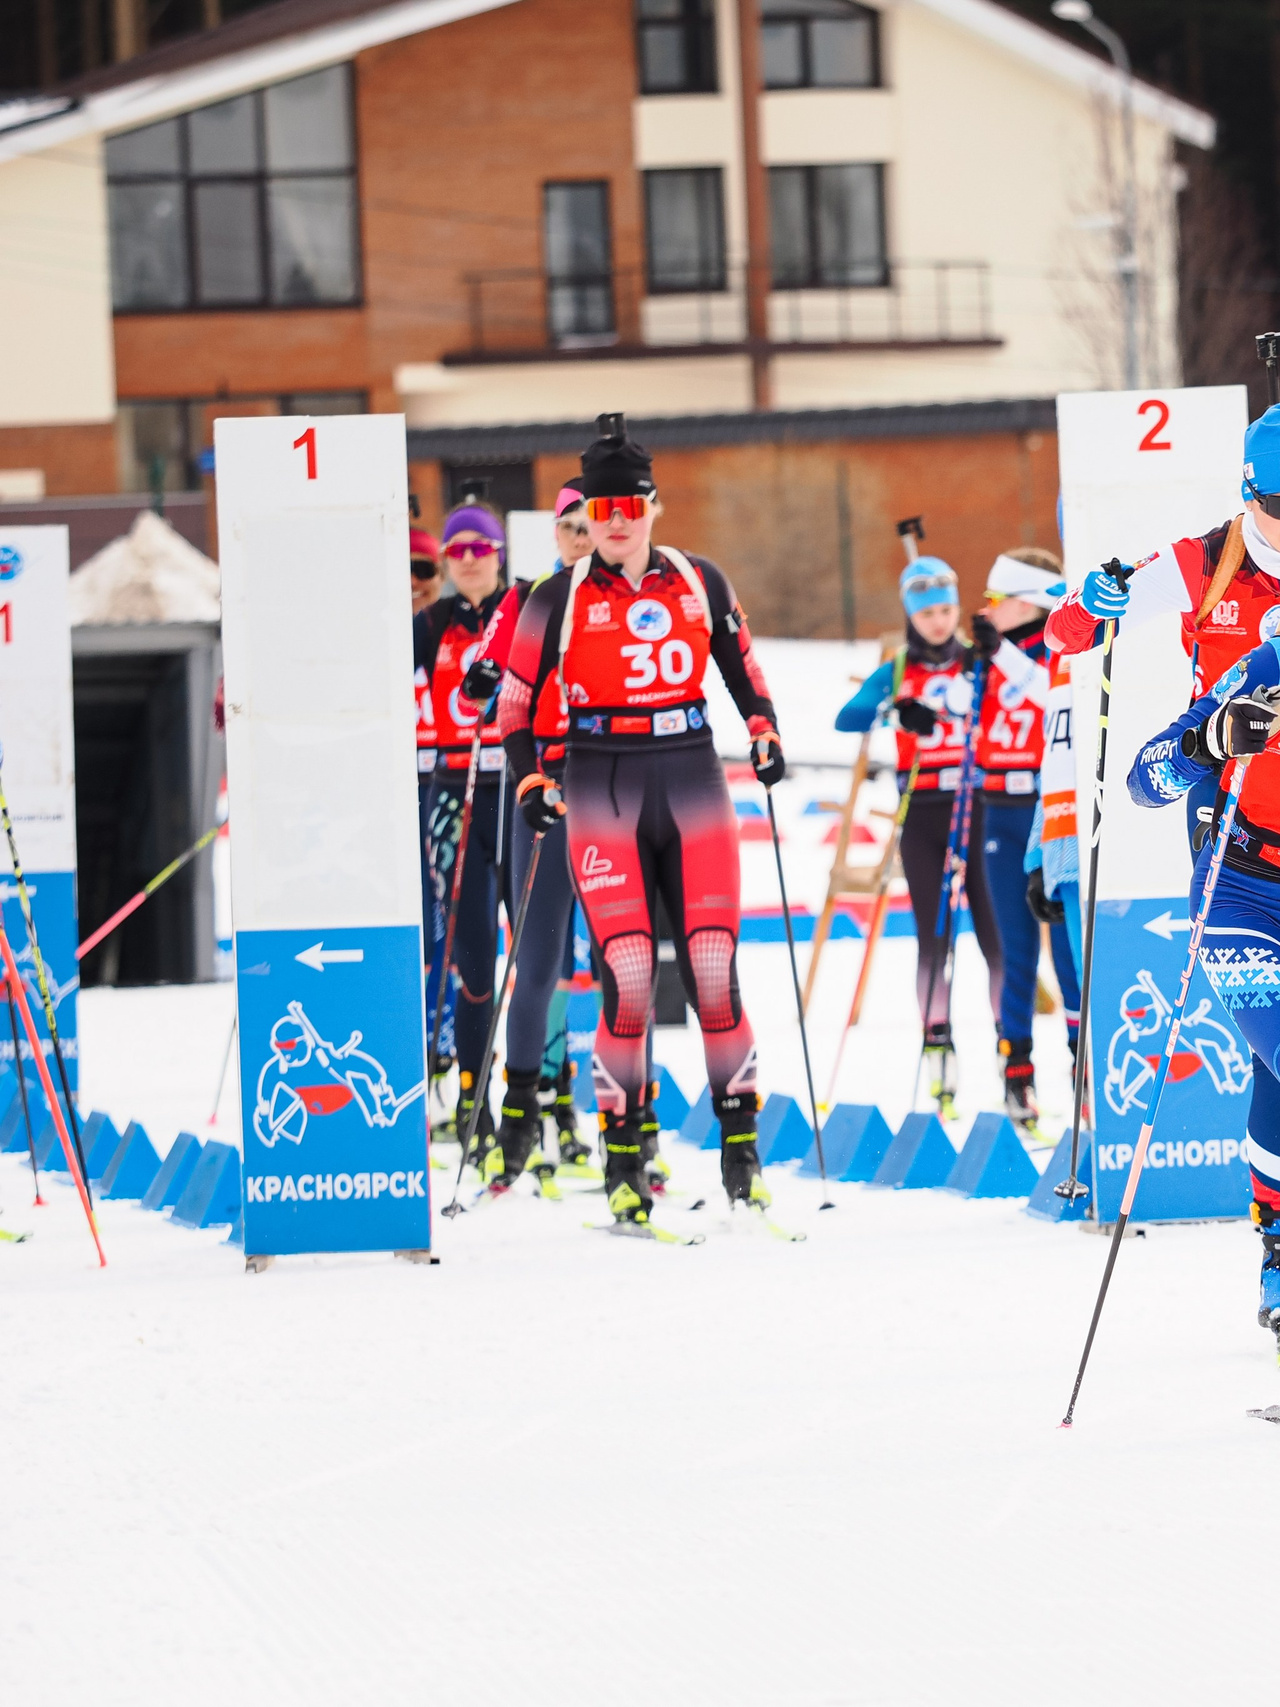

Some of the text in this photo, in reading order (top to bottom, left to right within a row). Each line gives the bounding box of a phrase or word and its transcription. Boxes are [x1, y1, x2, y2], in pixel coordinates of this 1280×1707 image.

[1137, 400, 1172, 451] 2
[293, 427, 318, 480] 1
[621, 639, 693, 689] 30
[988, 709, 1035, 749] 47
[1098, 1138, 1251, 1171] КРСНОЯРС
[247, 1171, 426, 1203] КРАСНОЯРСК
